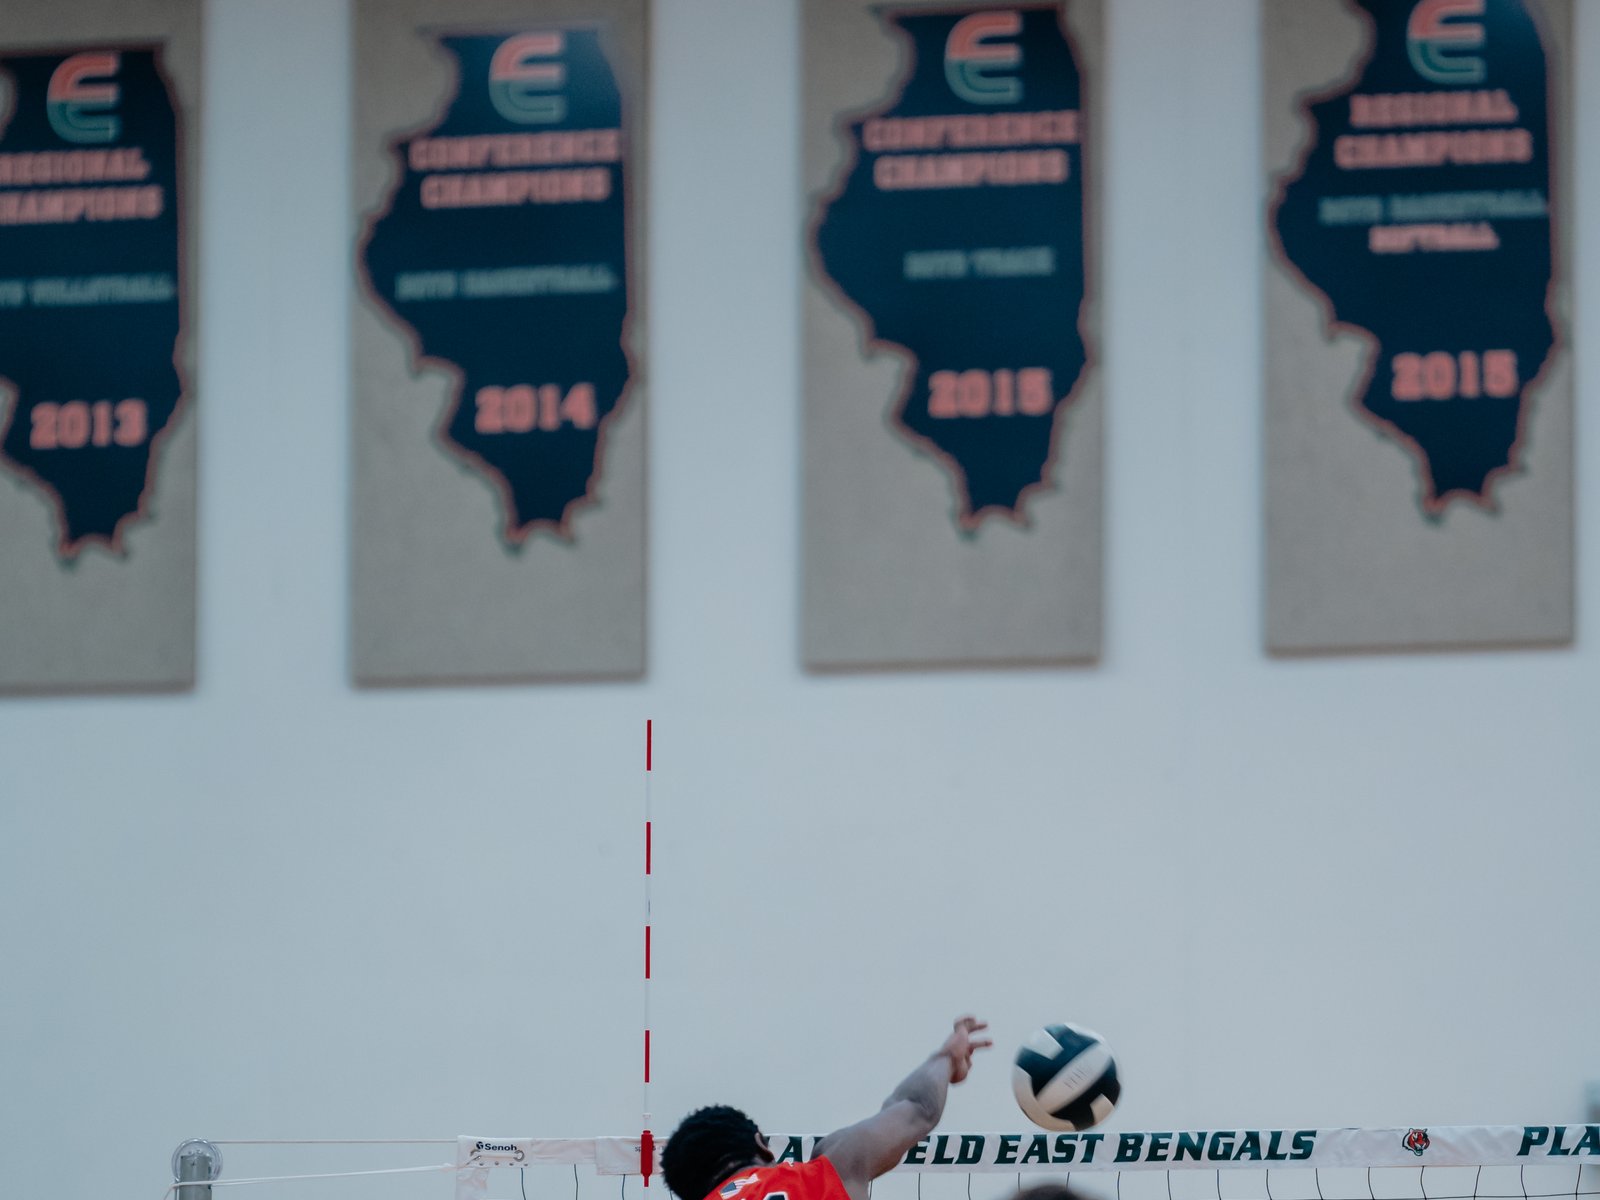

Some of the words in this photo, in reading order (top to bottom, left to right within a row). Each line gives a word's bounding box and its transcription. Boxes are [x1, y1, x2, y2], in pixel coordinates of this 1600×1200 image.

[873, 149, 1068, 191] CHAMPIONS
[1334, 128, 1532, 170] CHAMPIONS
[0, 185, 163, 225] HAMPIONS
[420, 167, 611, 209] CHAMPIONS
[1391, 350, 1518, 400] 2015
[30, 399, 147, 449] 2013
[475, 383, 597, 434] 2014
[484, 1143, 517, 1152] Senoh
[994, 1132, 1104, 1164] EAST
[1113, 1130, 1317, 1163] BENGALS
